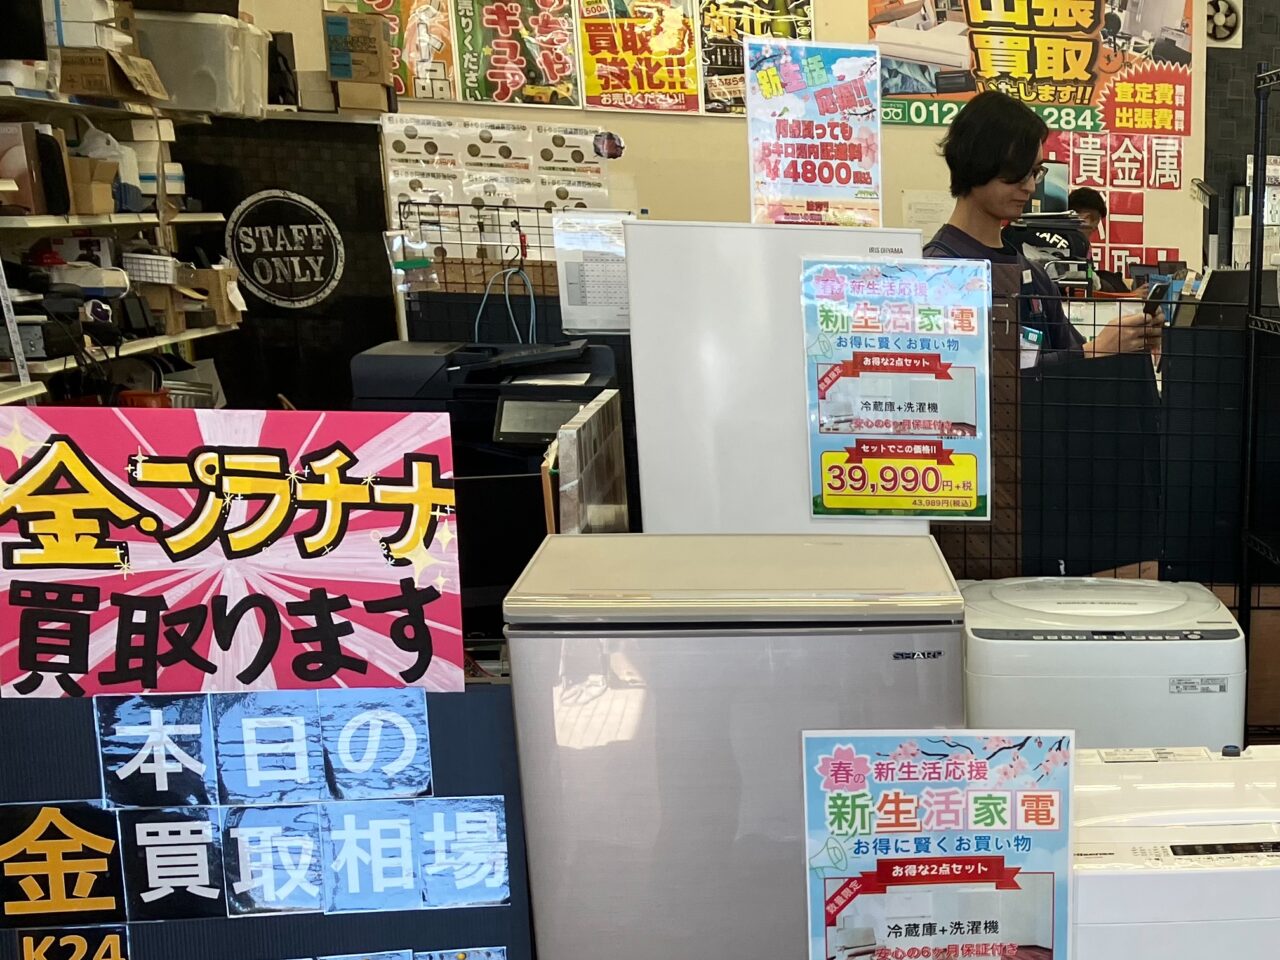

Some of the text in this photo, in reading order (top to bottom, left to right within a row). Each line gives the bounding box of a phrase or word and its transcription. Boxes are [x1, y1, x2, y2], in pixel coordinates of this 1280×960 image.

[973, 33, 1097, 81] 買取
[596, 56, 688, 90] 強化!!
[756, 54, 829, 99] 新生活
[1114, 82, 1175, 103] 査定費
[910, 102, 966, 125] 012
[1114, 108, 1175, 130] 出張費
[775, 119, 853, 141] 何点買っても
[1073, 137, 1182, 188] 貴金属
[239, 224, 327, 253] STAFF
[1036, 231, 1069, 249] AFF
[252, 254, 325, 286] ONLY
[850, 279, 929, 297] 新生活応援
[819, 303, 977, 333] 新生活家電
[836, 335, 960, 351] お得に賢くお買い物
[863, 357, 930, 368] お得な2点セット
[860, 401, 939, 414] 冷蔵庫+洗濯機
[0, 434, 455, 569] 金・プラチナ
[8, 577, 440, 697] 買取ります
[893, 650, 945, 660] SHARP
[115, 708, 418, 792] 本日の
[829, 760, 989, 784] 春の 新生活応援
[828, 791, 1056, 833] 新生活家電
[853, 835, 1033, 855] お得に賢くお買い物
[891, 862, 989, 878] お得な2点セット
[825, 880, 863, 915] 数量限定
[887, 920, 1000, 938] 冷蔵庫+洗濯機
